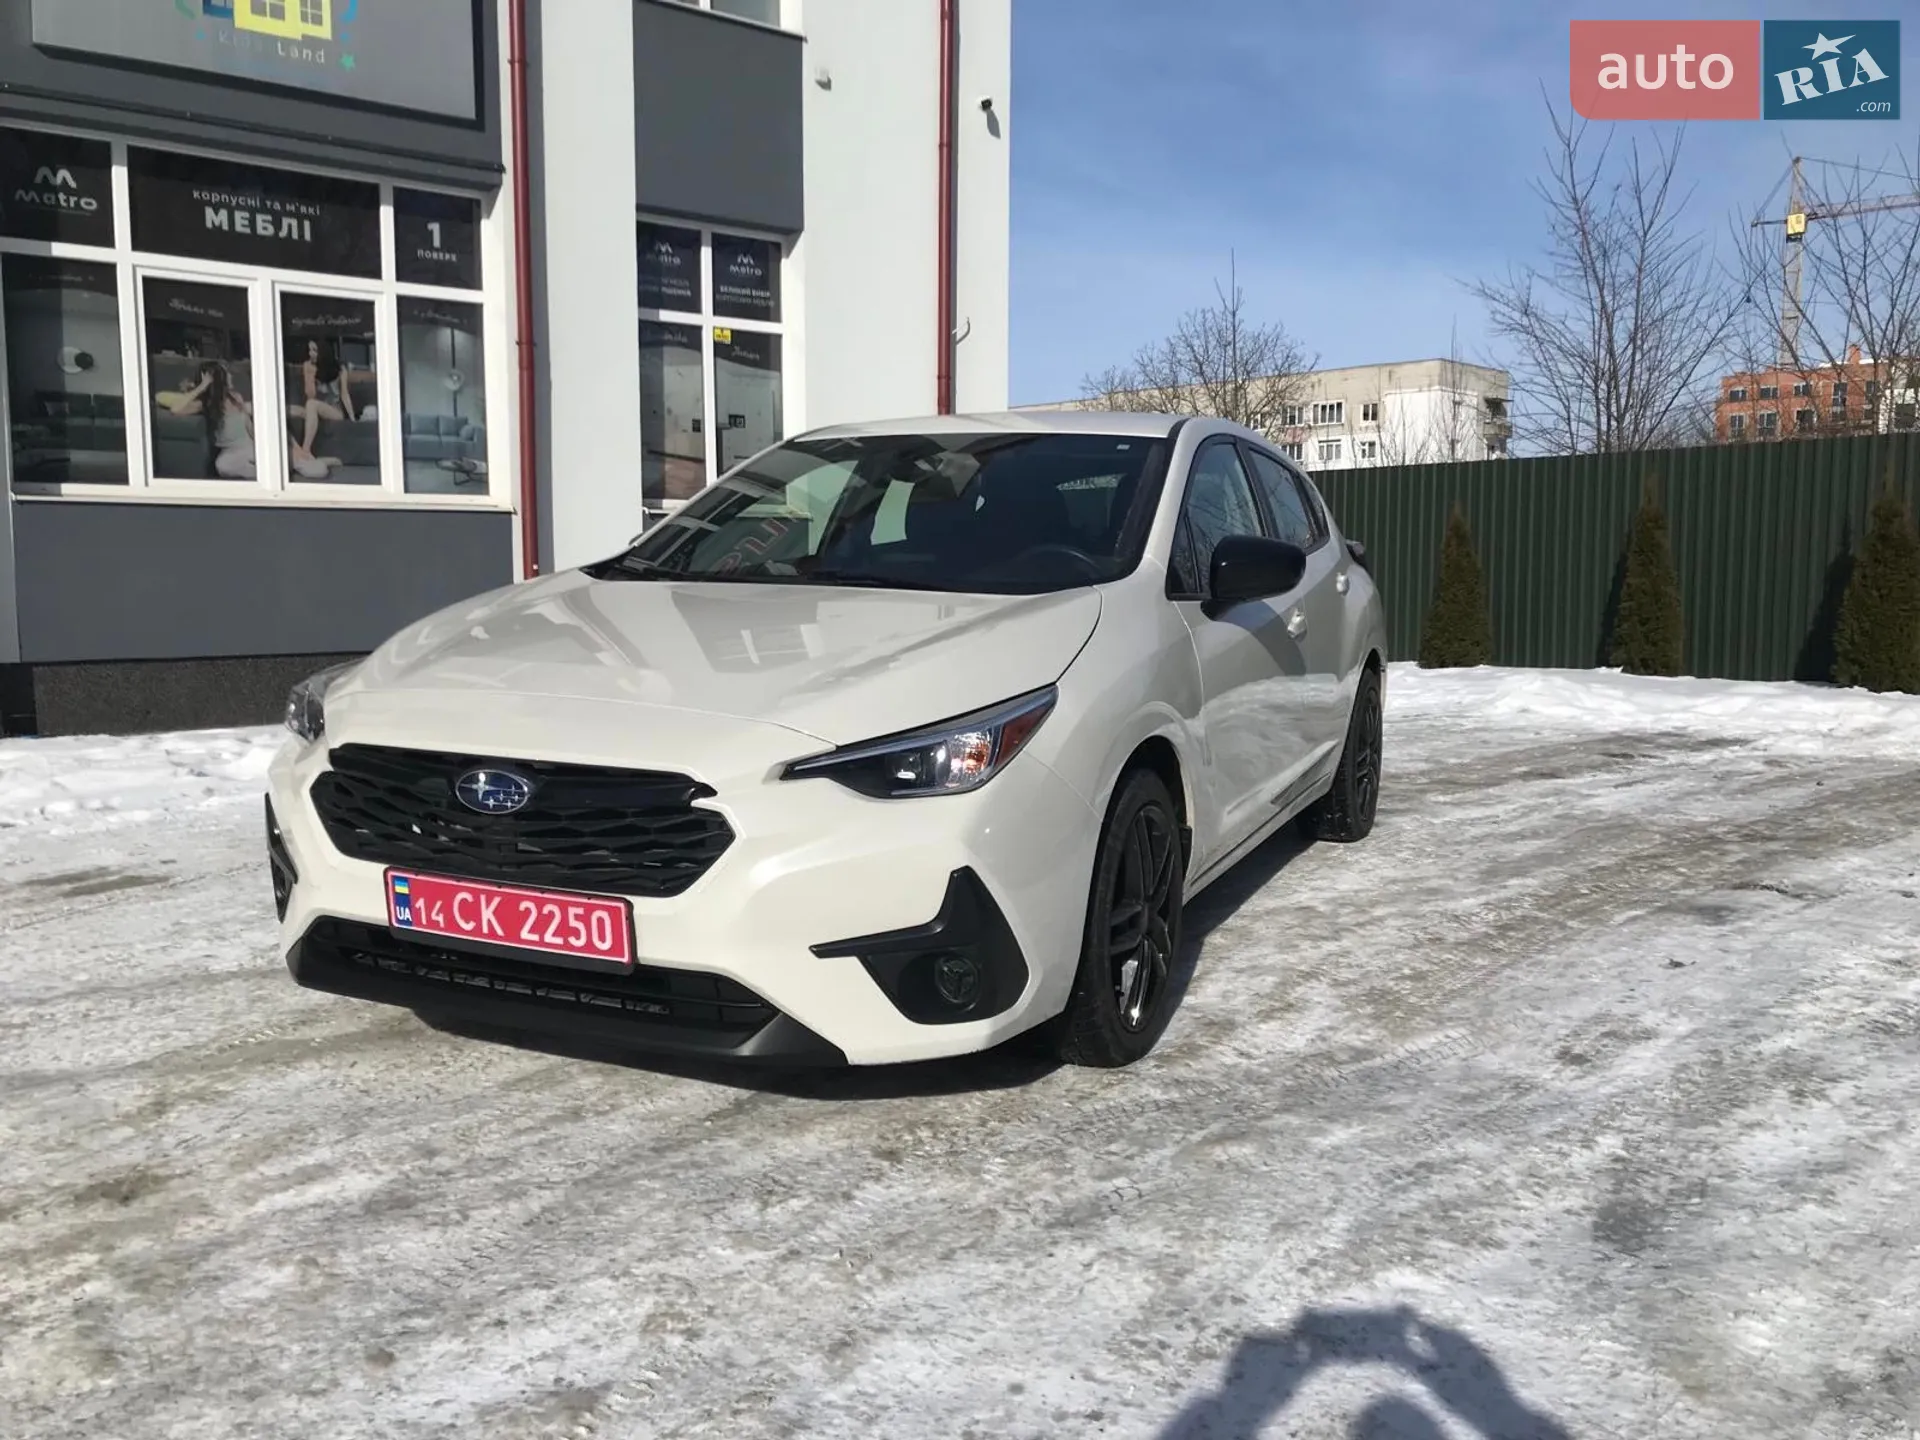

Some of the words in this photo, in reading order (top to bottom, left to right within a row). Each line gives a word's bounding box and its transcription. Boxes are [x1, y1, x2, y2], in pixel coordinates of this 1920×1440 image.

[277, 41, 325, 64] Land
[14, 189, 98, 211] Matro
[192, 189, 260, 207] корпусні
[265, 200, 281, 211] та
[204, 205, 312, 242] МЕБЛІ
[426, 221, 441, 249] 1
[396, 906, 412, 921] UA
[415, 898, 445, 928] 14
[452, 891, 505, 936] CK
[518, 900, 613, 951] 2250
